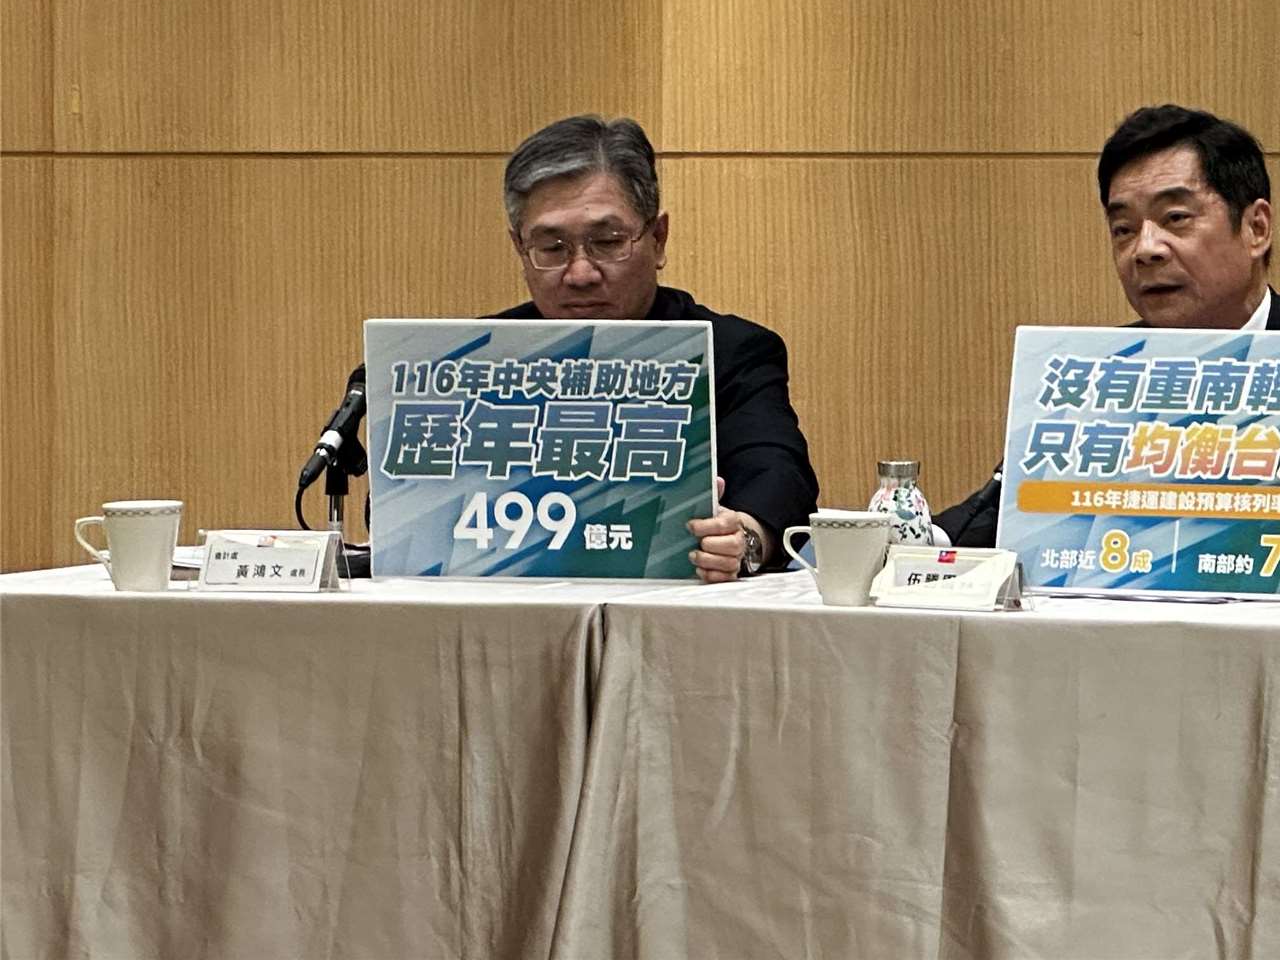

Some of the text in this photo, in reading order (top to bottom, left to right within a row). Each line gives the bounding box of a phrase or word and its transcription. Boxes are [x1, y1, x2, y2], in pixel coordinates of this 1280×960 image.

[391, 359, 699, 400] 116年中央補助地方
[380, 400, 692, 481] 歷年最高
[453, 492, 633, 550] 499 億元
[1040, 530, 1153, 573] 北部近8成
